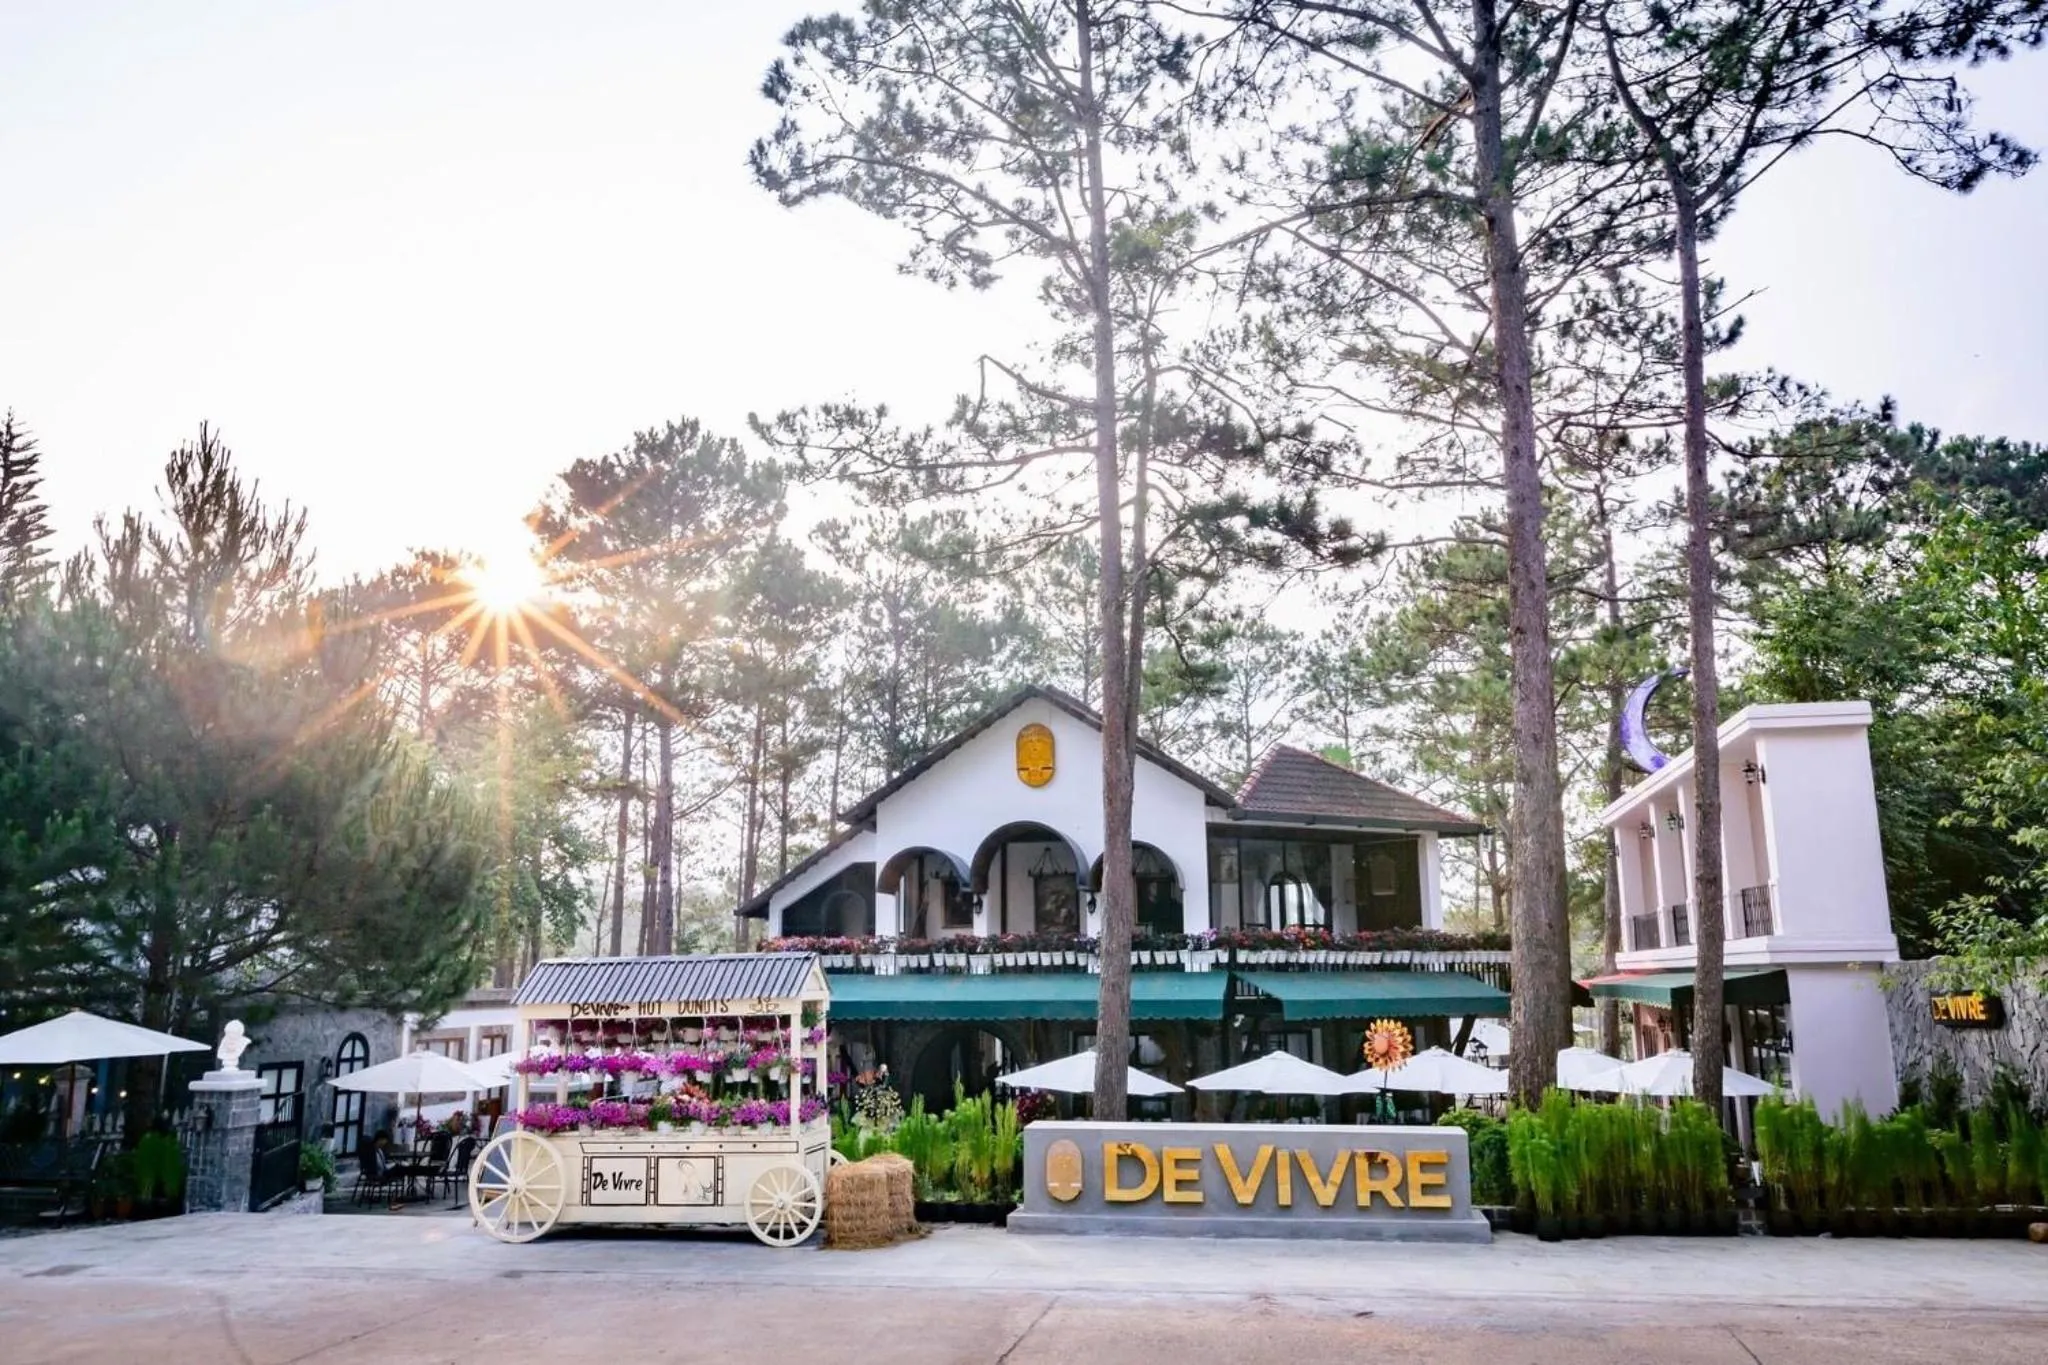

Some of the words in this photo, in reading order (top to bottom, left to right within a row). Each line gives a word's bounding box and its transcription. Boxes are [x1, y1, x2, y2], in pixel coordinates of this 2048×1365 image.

[1931, 997, 1947, 1020] DE
[1945, 994, 1986, 1020] VIVRE
[592, 1172, 608, 1190] De
[612, 1171, 643, 1191] Vivre
[1102, 1141, 1204, 1203] DE
[1213, 1143, 1452, 1208] VIVRE
